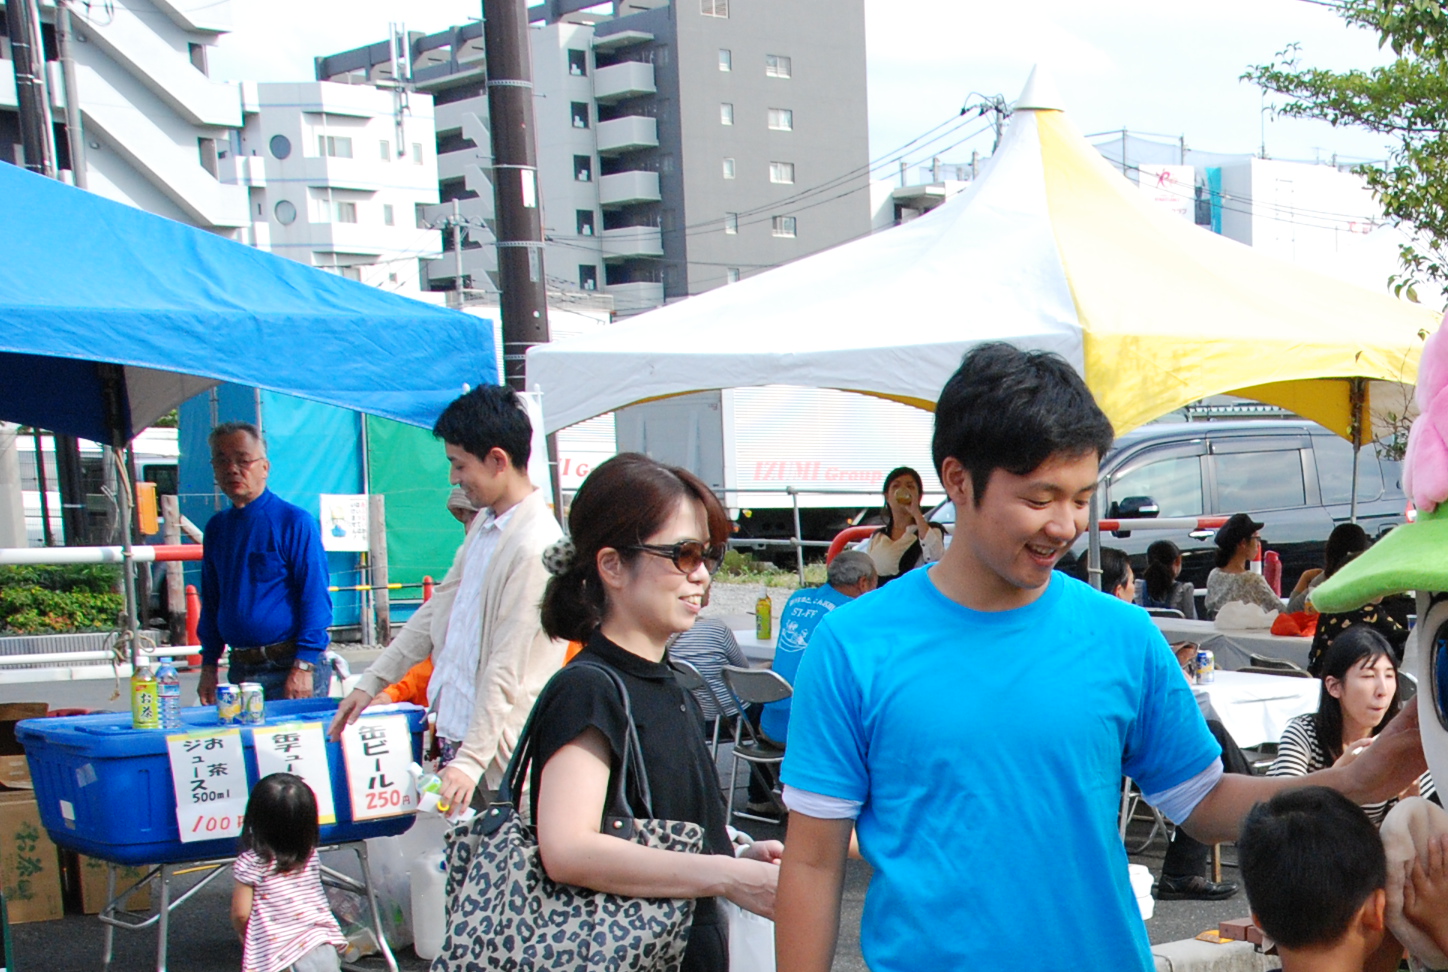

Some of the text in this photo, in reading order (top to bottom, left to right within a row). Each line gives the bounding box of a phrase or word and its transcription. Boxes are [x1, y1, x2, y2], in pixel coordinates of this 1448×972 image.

[753, 460, 883, 485] IZUMI Group
[140, 692, 153, 718] お茶
[183, 740, 207, 792] ジュース
[204, 738, 228, 777] お茶
[272, 733, 305, 780] 缶チュー
[358, 725, 394, 790] 缶ビール
[365, 789, 411, 810] 250円
